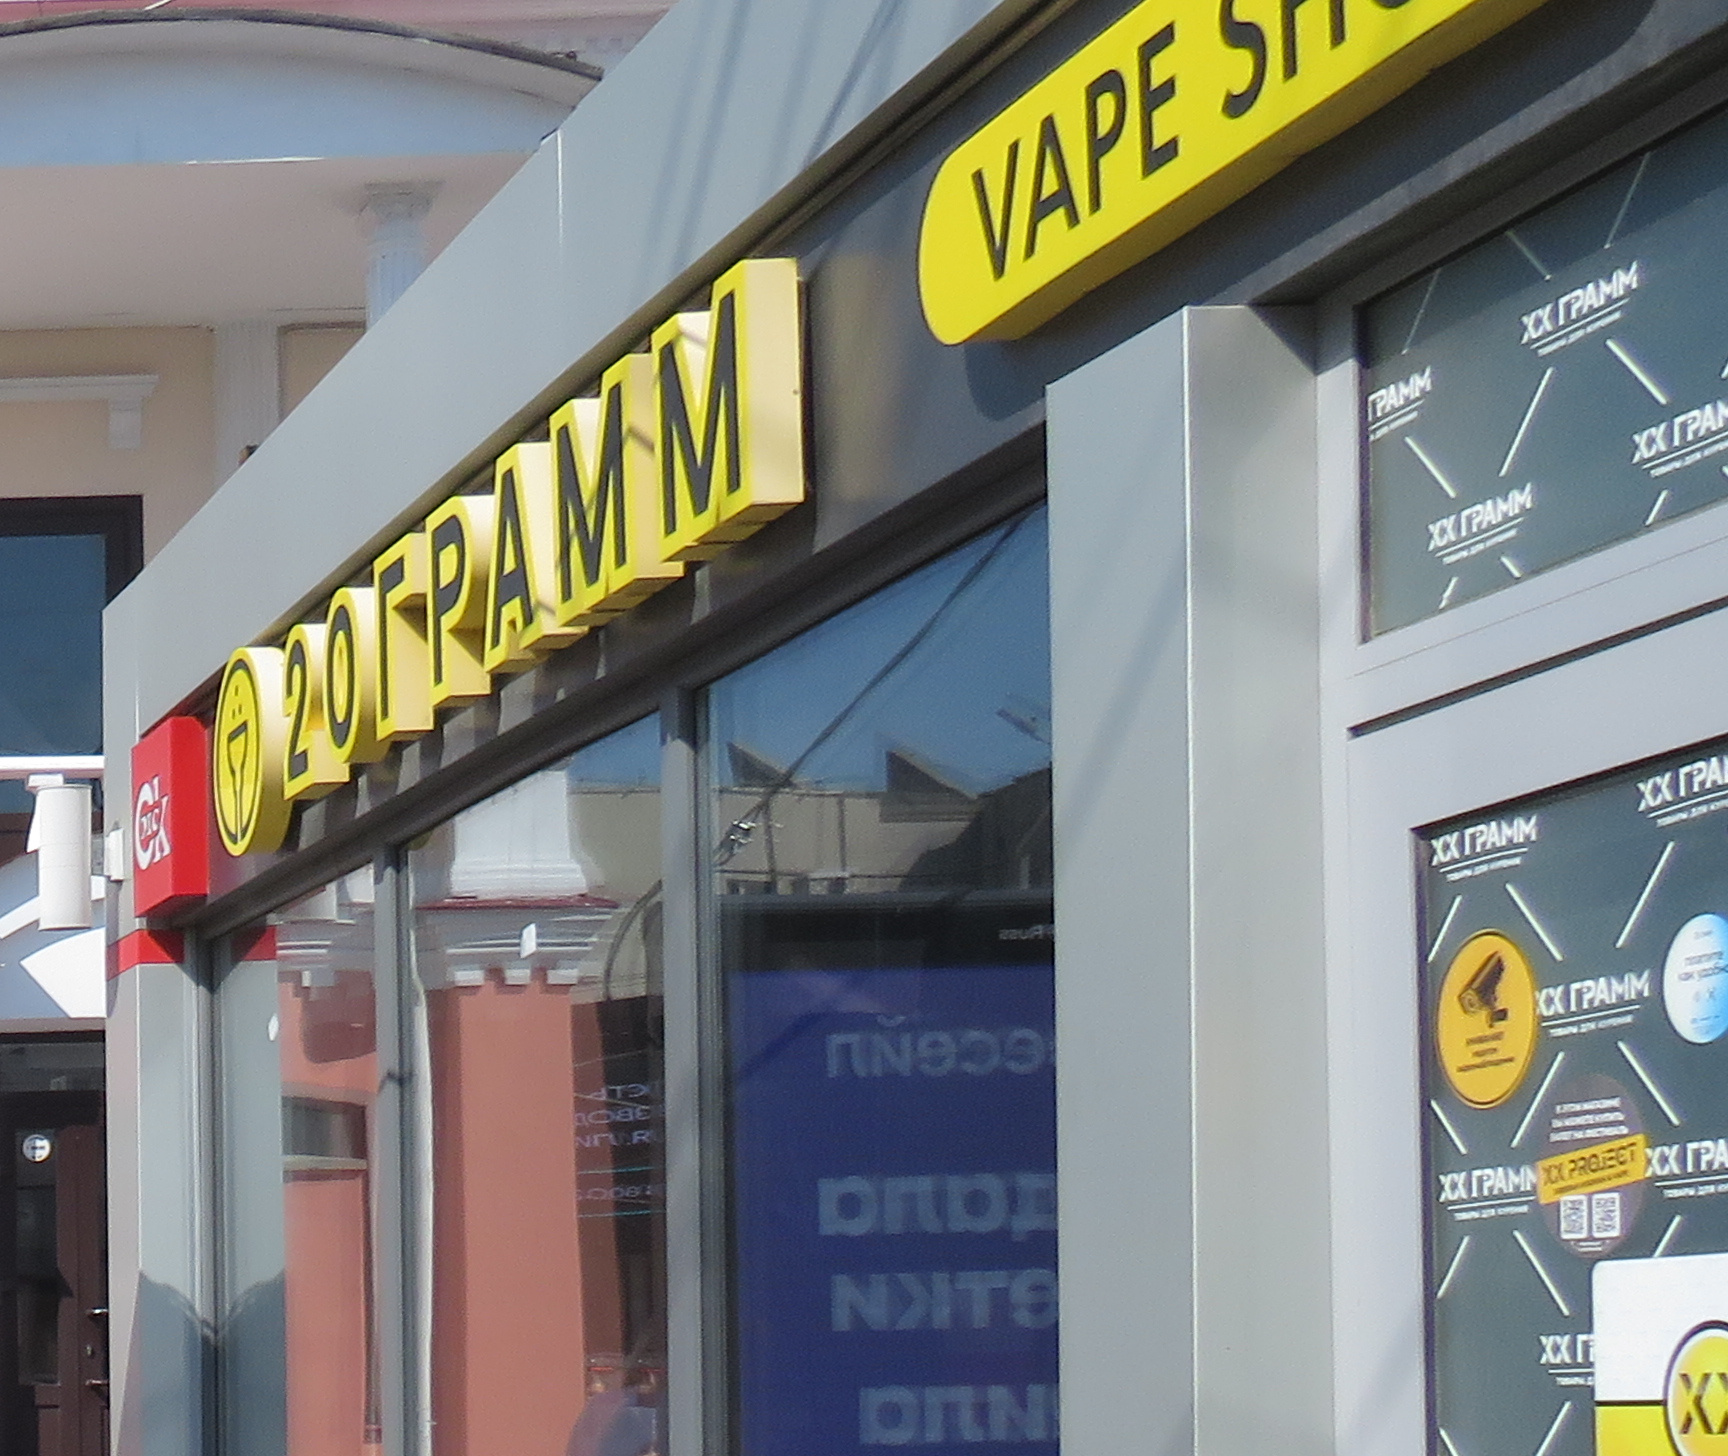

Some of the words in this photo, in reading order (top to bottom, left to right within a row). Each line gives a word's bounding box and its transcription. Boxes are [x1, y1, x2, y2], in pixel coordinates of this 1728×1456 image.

[971, 23, 1180, 282] VAPE
[1557, 259, 1639, 329] ГРАММ
[1459, 482, 1534, 539] ГРАММ
[1678, 760, 1728, 798] ГРА
[1463, 815, 1537, 856] ГРАММ
[1569, 968, 1652, 1012] ГРАММ
[1568, 1142, 1637, 1179] PROJECT
